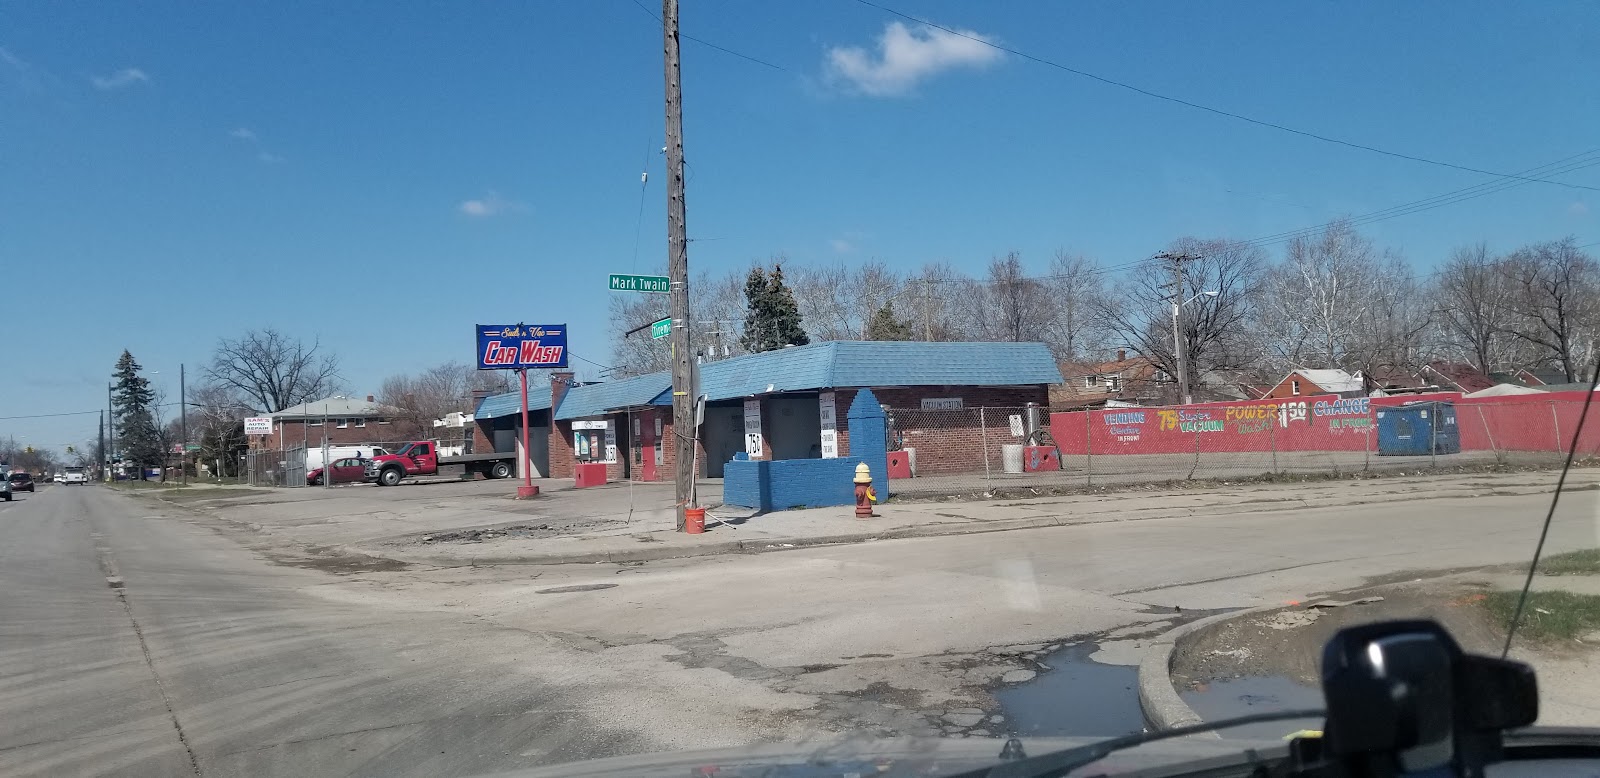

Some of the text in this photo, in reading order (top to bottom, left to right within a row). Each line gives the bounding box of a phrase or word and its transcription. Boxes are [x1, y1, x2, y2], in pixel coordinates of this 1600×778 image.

[612, 276, 667, 291] Mark Twain
[1103, 412, 1145, 425] VENDING
[1225, 404, 1278, 420] POWER
[1180, 420, 1224, 432] VACUUM
